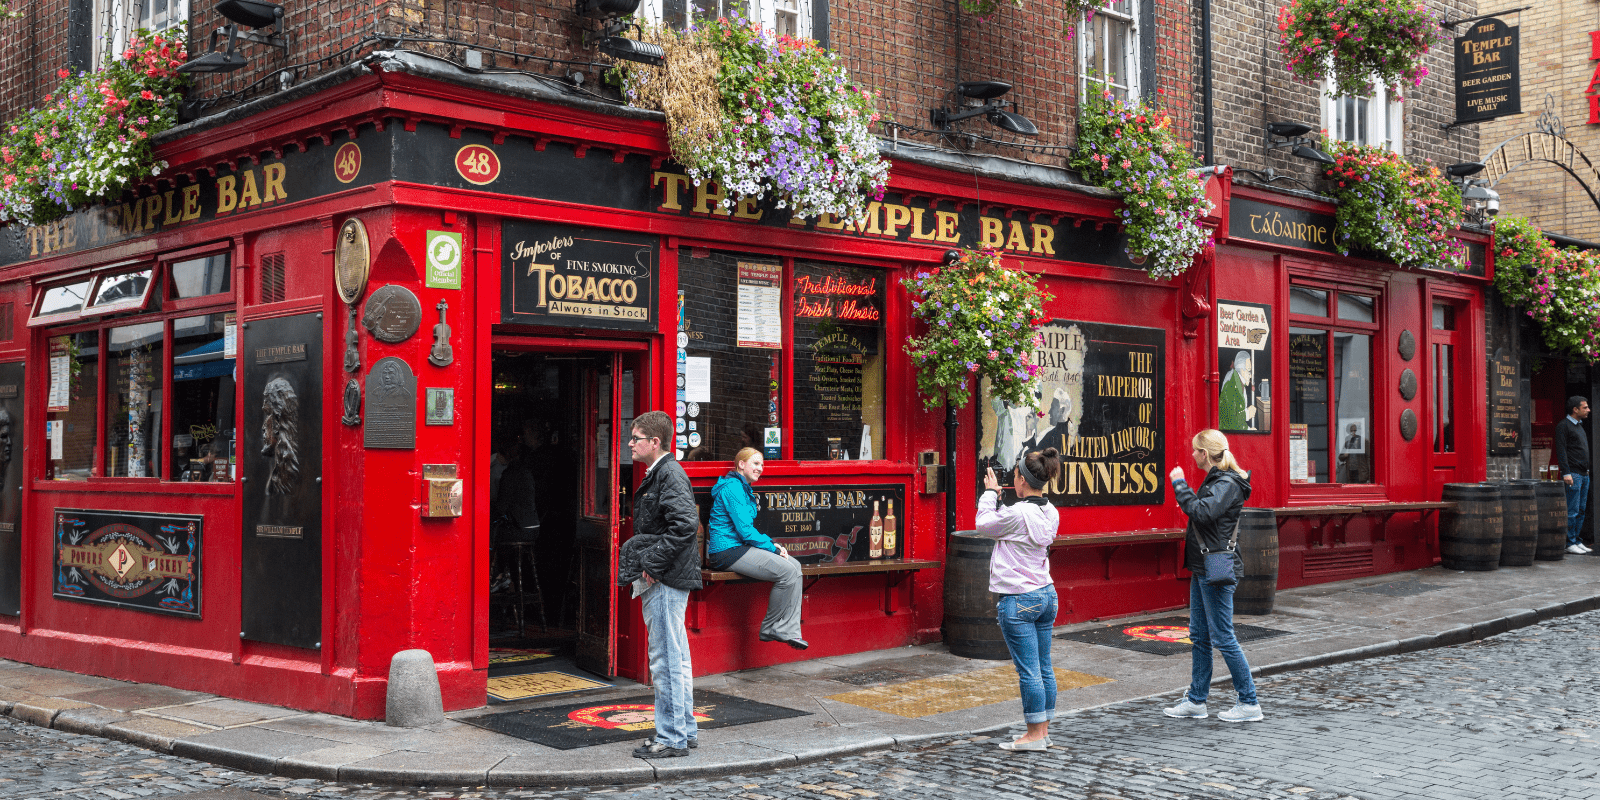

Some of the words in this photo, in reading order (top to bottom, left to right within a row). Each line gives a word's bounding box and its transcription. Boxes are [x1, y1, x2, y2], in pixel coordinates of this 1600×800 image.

[1477, 24, 1495, 34] THE
[1462, 36, 1513, 55] TEMPLE
[1473, 51, 1501, 65] BAR
[1462, 78, 1481, 87] BEER
[1482, 73, 1512, 84] GARDEN
[1467, 98, 1483, 107] LIVE
[1485, 95, 1508, 104] MUSIC
[1477, 103, 1498, 112] DAILY
[339, 150, 356, 176] 48
[463, 150, 491, 175] 48
[215, 162, 288, 214] BAR
[788, 197, 959, 244] EMPLE
[980, 215, 1054, 257] BAR
[510, 236, 574, 263] Importers
[567, 260, 590, 272] FINE
[592, 262, 637, 276] SMOKING
[527, 262, 638, 308] TOBACCO
[797, 275, 877, 295] Traditional
[550, 301, 593, 315] Always
[599, 306, 609, 315] in
[614, 306, 646, 319] Stock
[796, 296, 832, 317] Irish
[839, 299, 880, 321] Music
[1219, 306, 1234, 320] Beer
[1236, 308, 1258, 323] Garden
[1219, 321, 1247, 337] Smoking
[812, 333, 849, 352] TEMPLE
[851, 337, 867, 356] BAR
[1040, 332, 1083, 351] MPLE
[1225, 334, 1241, 347] Area
[1037, 350, 1068, 371] BAR
[1129, 351, 1152, 374] THE
[1496, 361, 1516, 375] TEMPLE
[1098, 375, 1152, 399] EMPEROR
[1501, 375, 1513, 387] BAR
[1138, 403, 1152, 424] OF
[1060, 433, 1109, 459] MALTED
[1110, 426, 1157, 455] LIQUORS
[765, 491, 832, 511] TEMPLE
[835, 490, 867, 509] BAR
[781, 512, 816, 522] DUBLIN
[785, 525, 798, 533] EST.
[785, 543, 808, 552] MUSIC
[808, 541, 831, 551] DAILY
[71, 549, 104, 566] POWERS
[118, 548, 129, 574] P
